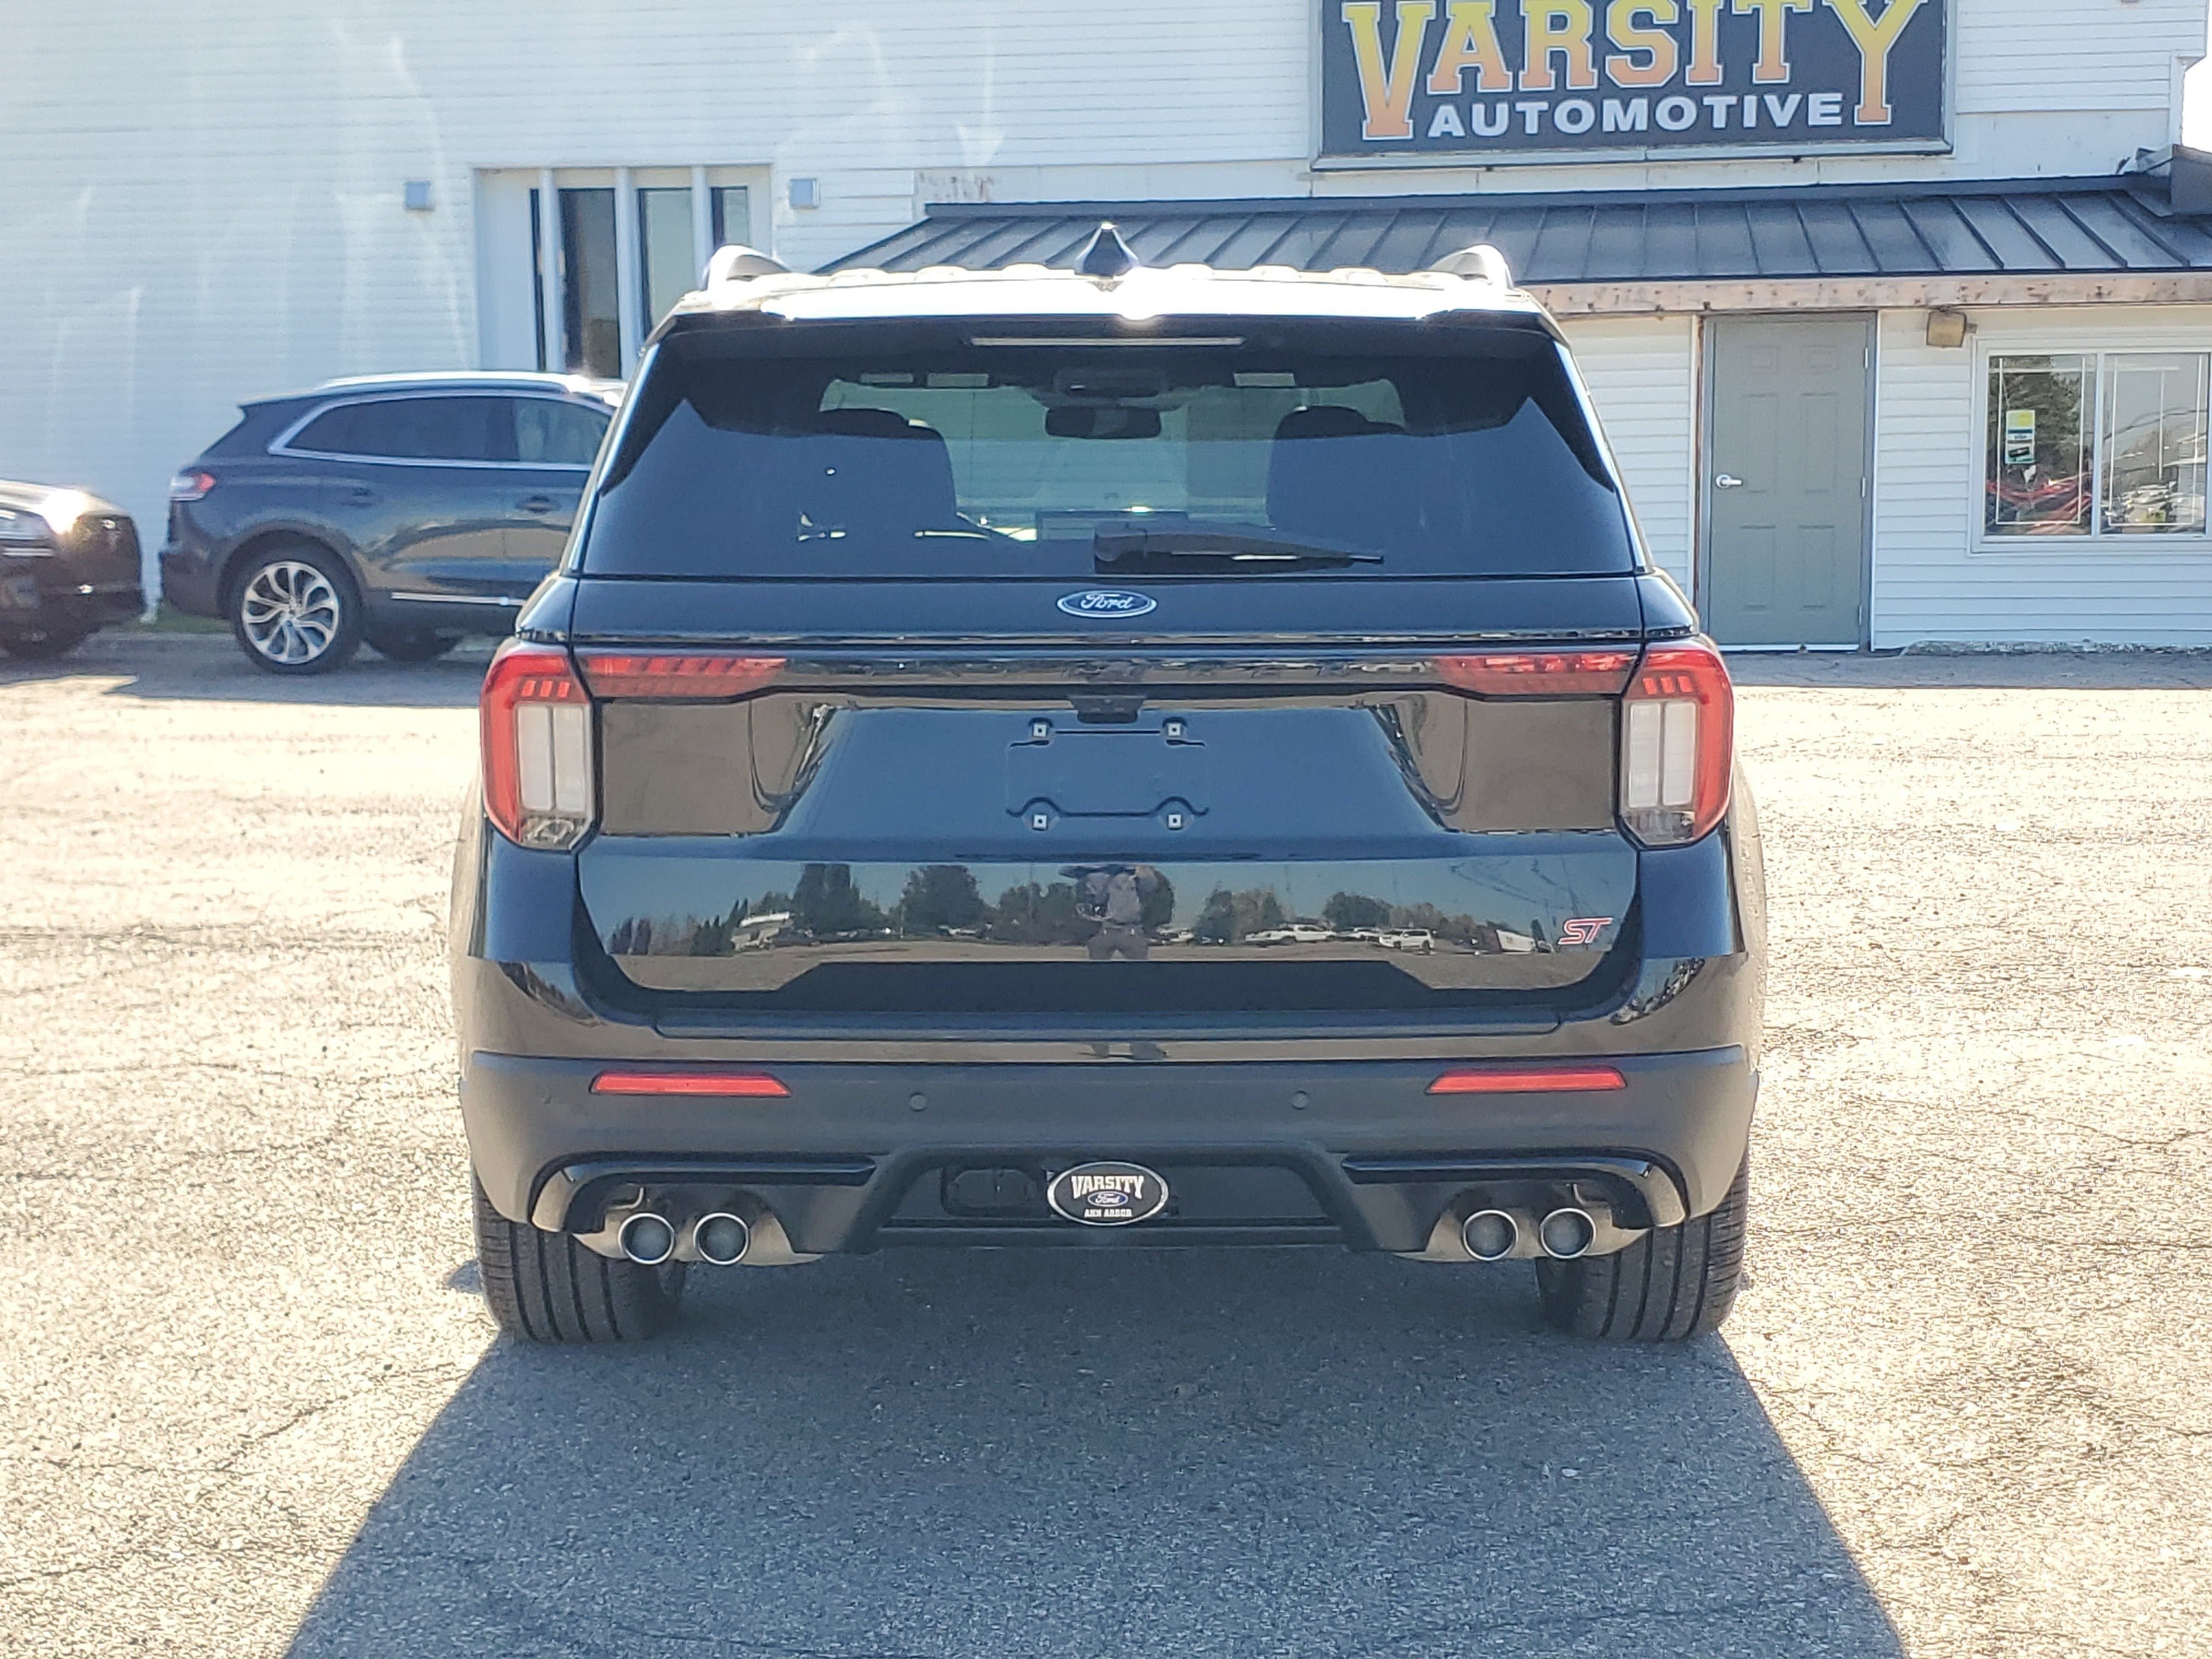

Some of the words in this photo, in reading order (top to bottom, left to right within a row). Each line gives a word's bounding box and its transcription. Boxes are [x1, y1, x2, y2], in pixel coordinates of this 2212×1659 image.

[1342, 0, 1928, 140] VARSITY
[1427, 94, 1843, 138] AUTOMOTIVE
[1080, 594, 1133, 609] Ford
[1558, 917, 1613, 945] ST
[1071, 1175, 1144, 1200] VARSITY
[1095, 1193, 1120, 1203] Ford
[1084, 1209, 1102, 1217] ANN
[1103, 1209, 1132, 1217] ARBOR
